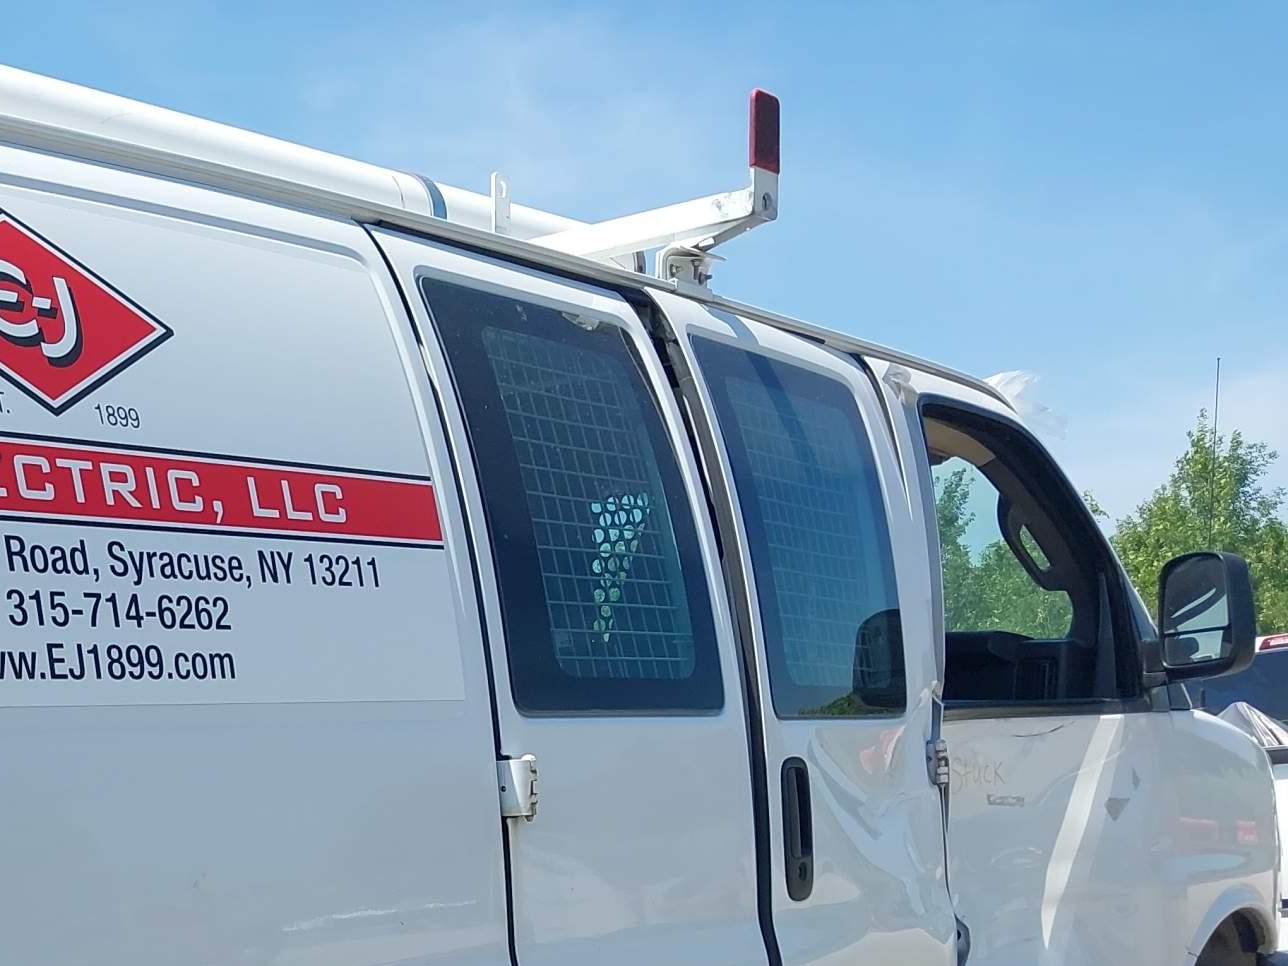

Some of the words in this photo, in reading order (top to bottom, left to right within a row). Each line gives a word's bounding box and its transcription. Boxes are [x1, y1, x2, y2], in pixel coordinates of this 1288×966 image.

[94, 403, 141, 429] 1899
[247, 476, 347, 523] LLC
[5, 534, 101, 582] Road,
[108, 541, 253, 588] Syracuse,
[257, 551, 294, 585] NY
[302, 553, 381, 589] 13211
[7, 589, 232, 630] 315-714-6262
